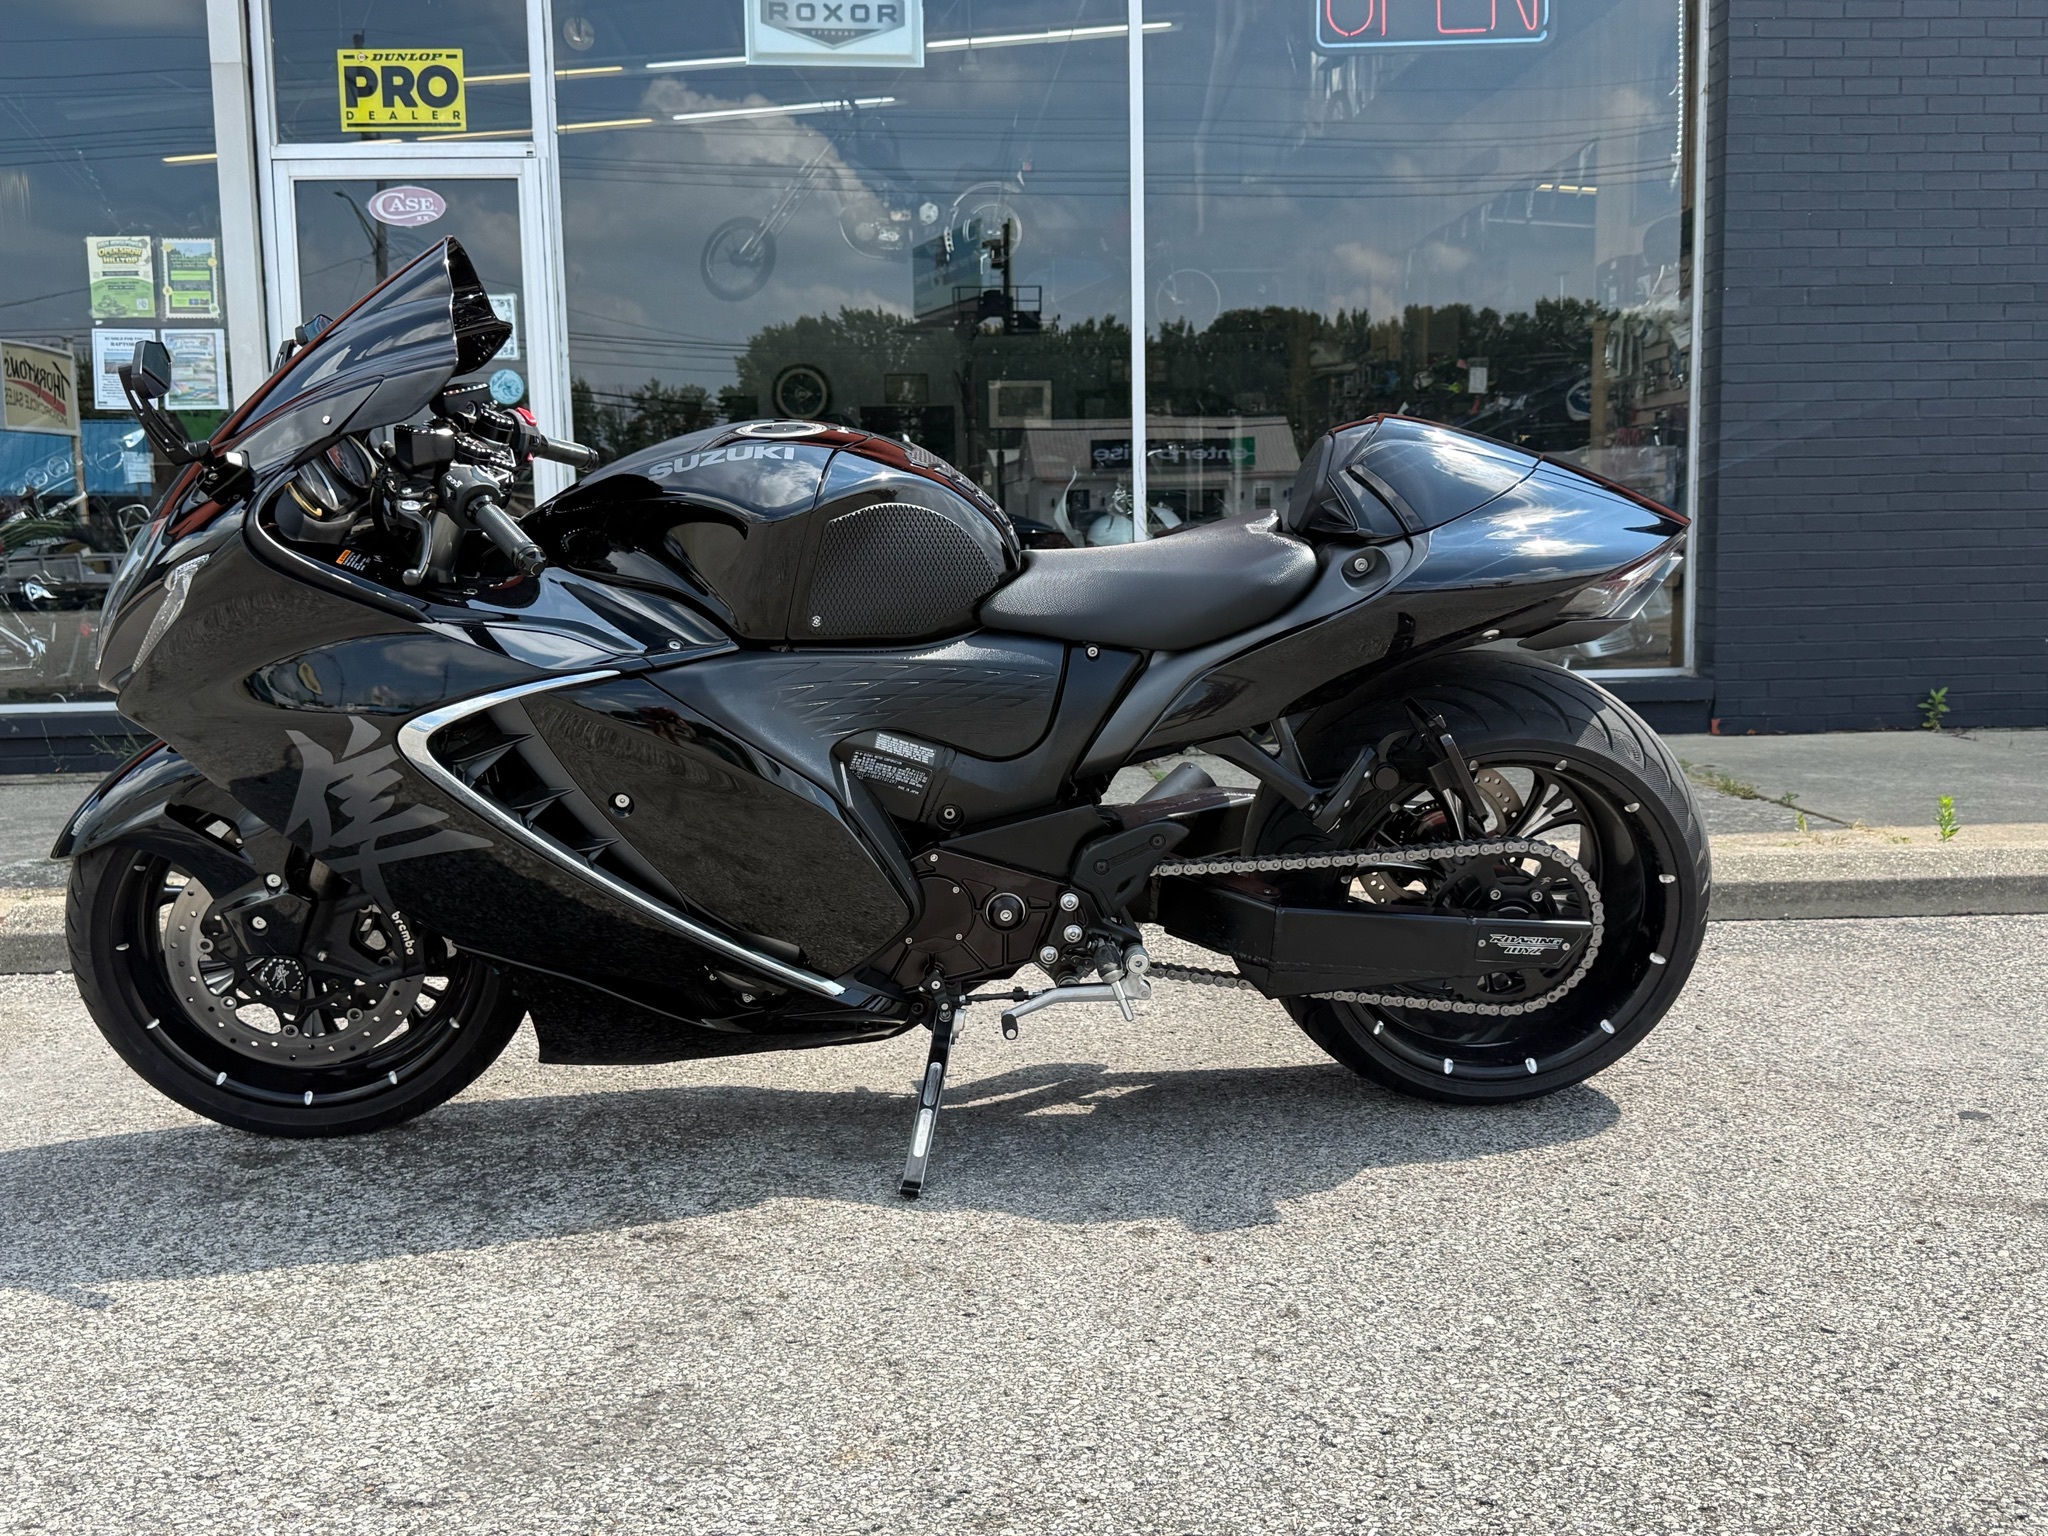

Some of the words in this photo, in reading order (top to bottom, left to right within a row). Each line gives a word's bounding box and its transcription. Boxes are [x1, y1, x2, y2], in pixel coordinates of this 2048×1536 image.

[768, 2, 897, 23] ROXOR
[371, 53, 443, 62] DUNLOP
[344, 65, 459, 108] PRO
[346, 111, 461, 120] DEALER
[648, 446, 795, 481] SUZUKI
[391, 910, 415, 955] brembo
